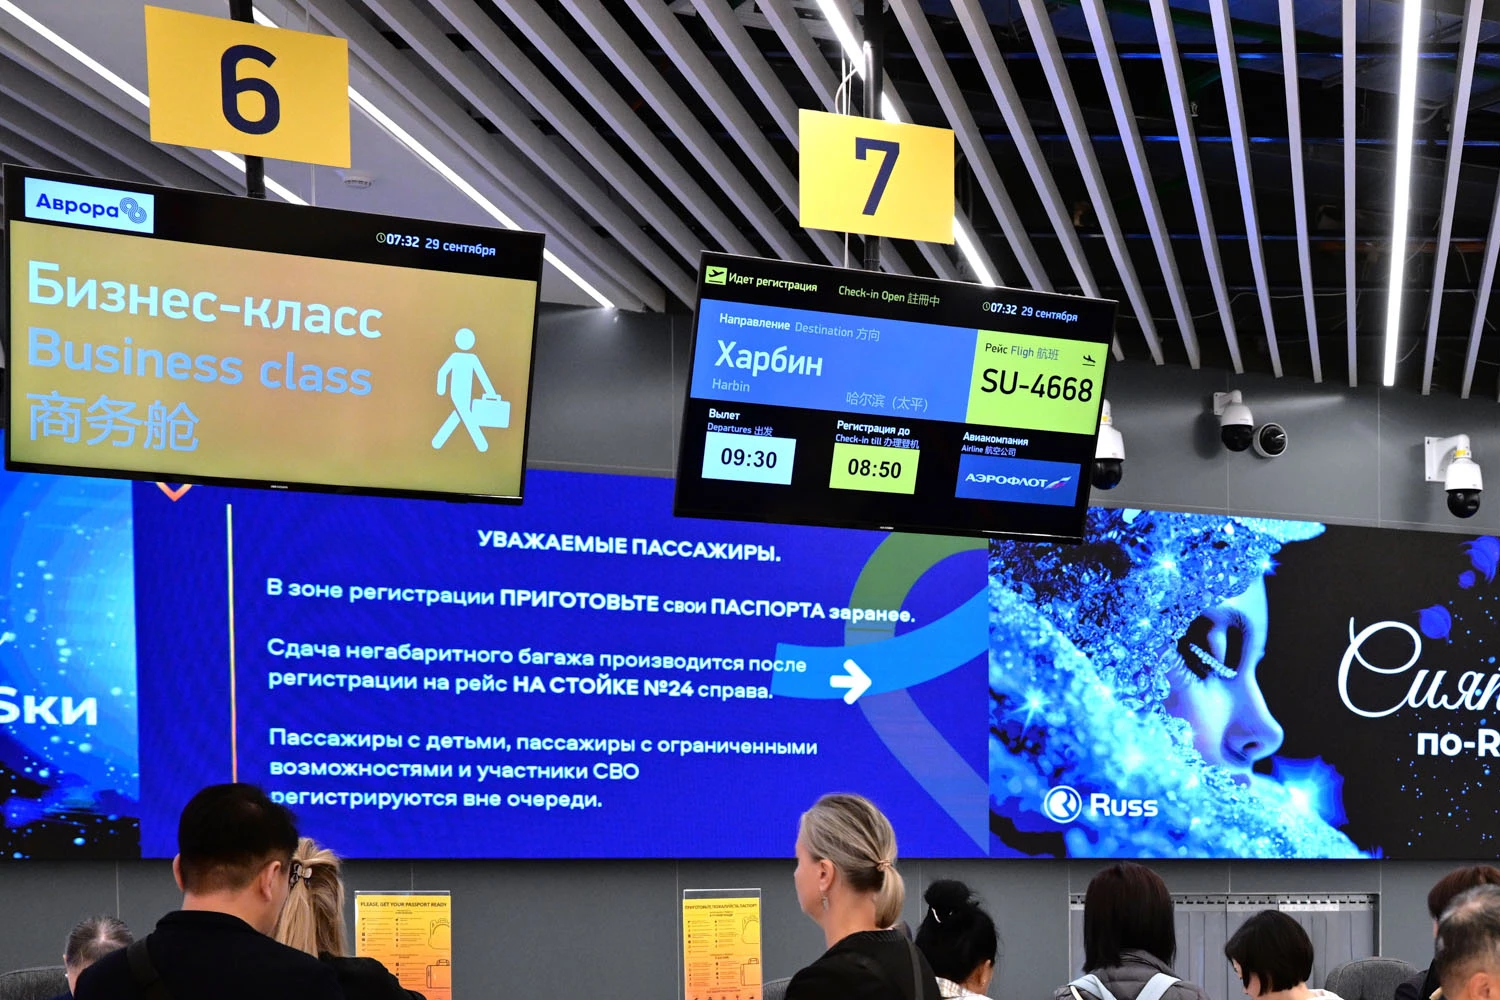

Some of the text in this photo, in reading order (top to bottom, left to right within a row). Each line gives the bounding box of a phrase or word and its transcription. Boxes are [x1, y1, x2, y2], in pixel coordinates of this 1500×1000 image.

[220, 44, 280, 135] 6
[854, 136, 900, 216] 7
[36, 193, 119, 219] Аврора
[386, 233, 496, 258] 07:32 29 сентября
[729, 271, 817, 292] Идет регистрация
[28, 260, 383, 340] Бизнес-класс
[839, 286, 939, 306] Check-in Open 註冊中
[990, 303, 1078, 322] 07:32 29 сентября
[720, 313, 880, 341] Направление Destination 方向
[27, 327, 373, 396] Business class
[715, 340, 822, 376] Харбин
[985, 343, 1059, 360] Рейс Fligh 航班
[712, 378, 750, 392] Harbin
[981, 368, 1093, 402] SU-4668
[26, 390, 200, 453] 商务舱
[709, 408, 740, 420] Вылет
[707, 423, 773, 437] Departures 出发
[837, 420, 910, 436] Регистрация до
[963, 432, 1029, 446] Авиакомпания
[721, 448, 776, 468] 09:30
[848, 459, 901, 478] 08:50
[965, 473, 1048, 488] АЭРОФЛОТ
[478, 530, 780, 561] УВАЖАЕМЫЕ ПАССАЖИРЫ.
[267, 578, 915, 624] В зоне регистрации ПРИГОТОВЬТЕ свои ПАСПОРТА заранее.
[268, 638, 806, 672] Сдача негабаритного багажа производится после
[269, 672, 772, 701] регистрации на рейс НА СТОЙКЕ №24 справа.
[270, 728, 817, 756] Пассажиры с детьми, пассажиры с ограниченными
[271, 762, 639, 782] возможностями и участники СВО
[271, 792, 602, 810] регистрируются вне очереди.
